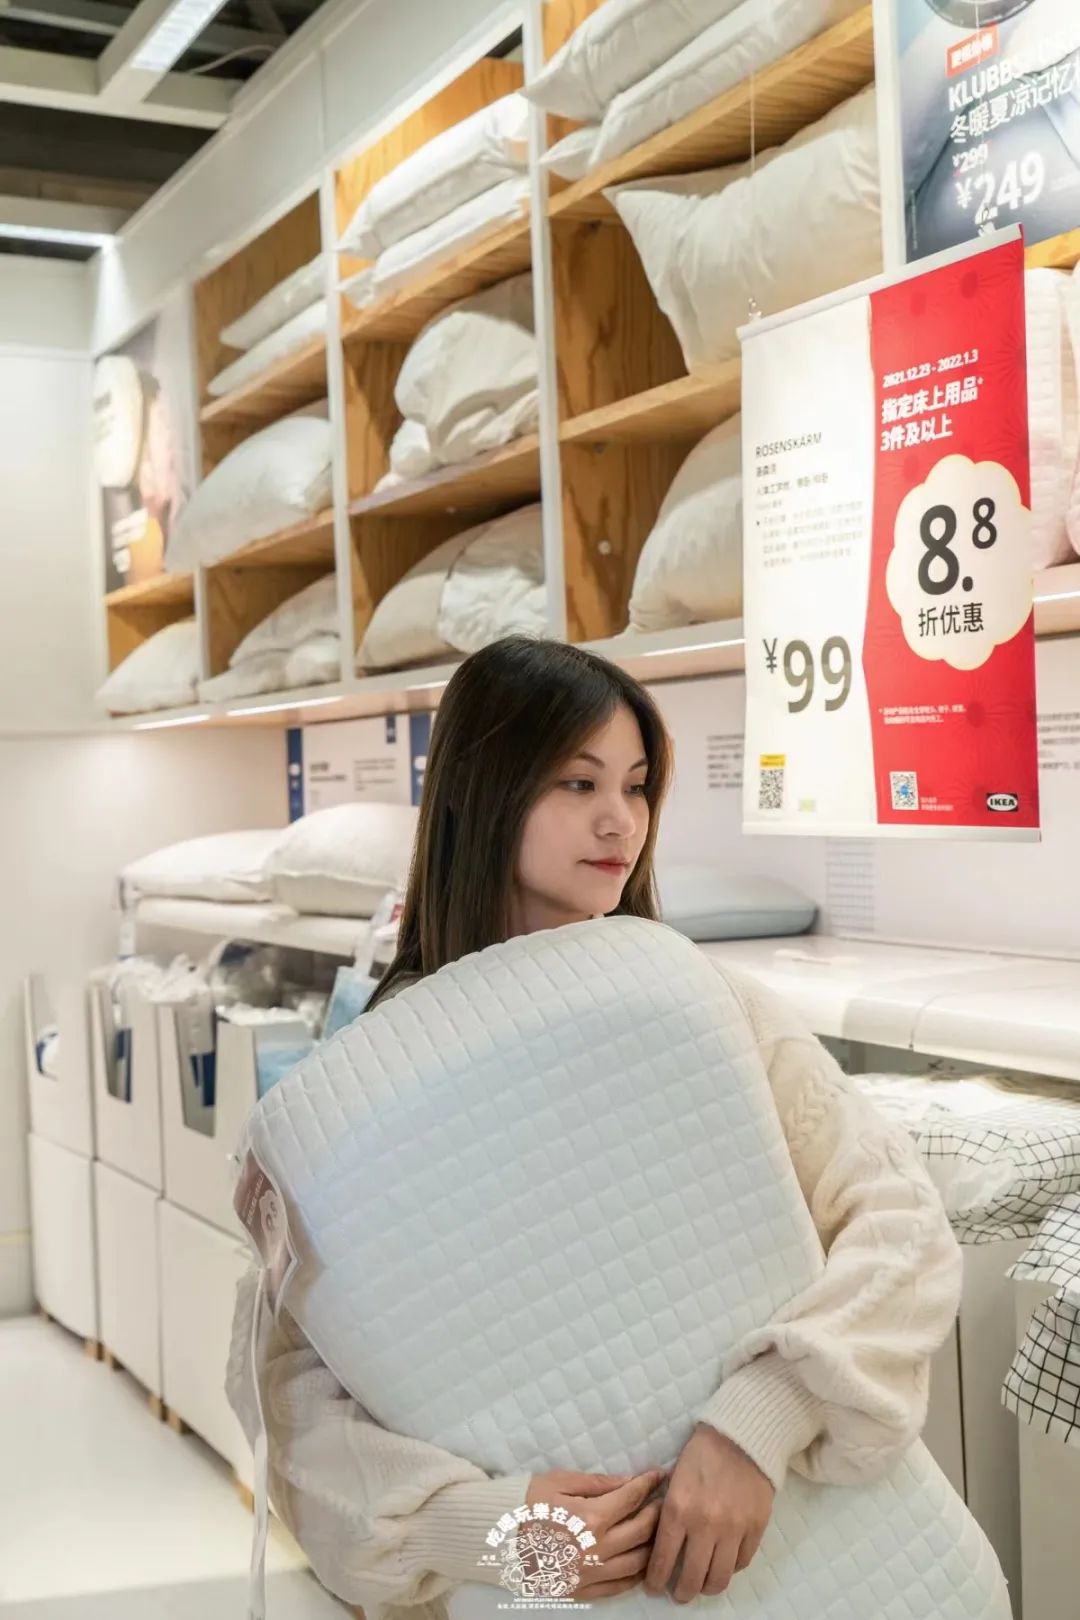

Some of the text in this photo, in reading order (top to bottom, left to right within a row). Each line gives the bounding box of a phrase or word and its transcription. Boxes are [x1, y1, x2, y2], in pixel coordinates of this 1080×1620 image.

[955, 151, 1044, 225] ¥249
[937, 348, 979, 373] 2022.1.3
[880, 413, 953, 452] 3件及以上
[918, 602, 984, 637] 折优惠
[762, 634, 852, 714] ¥99
[989, 797, 1016, 807] IKEA
